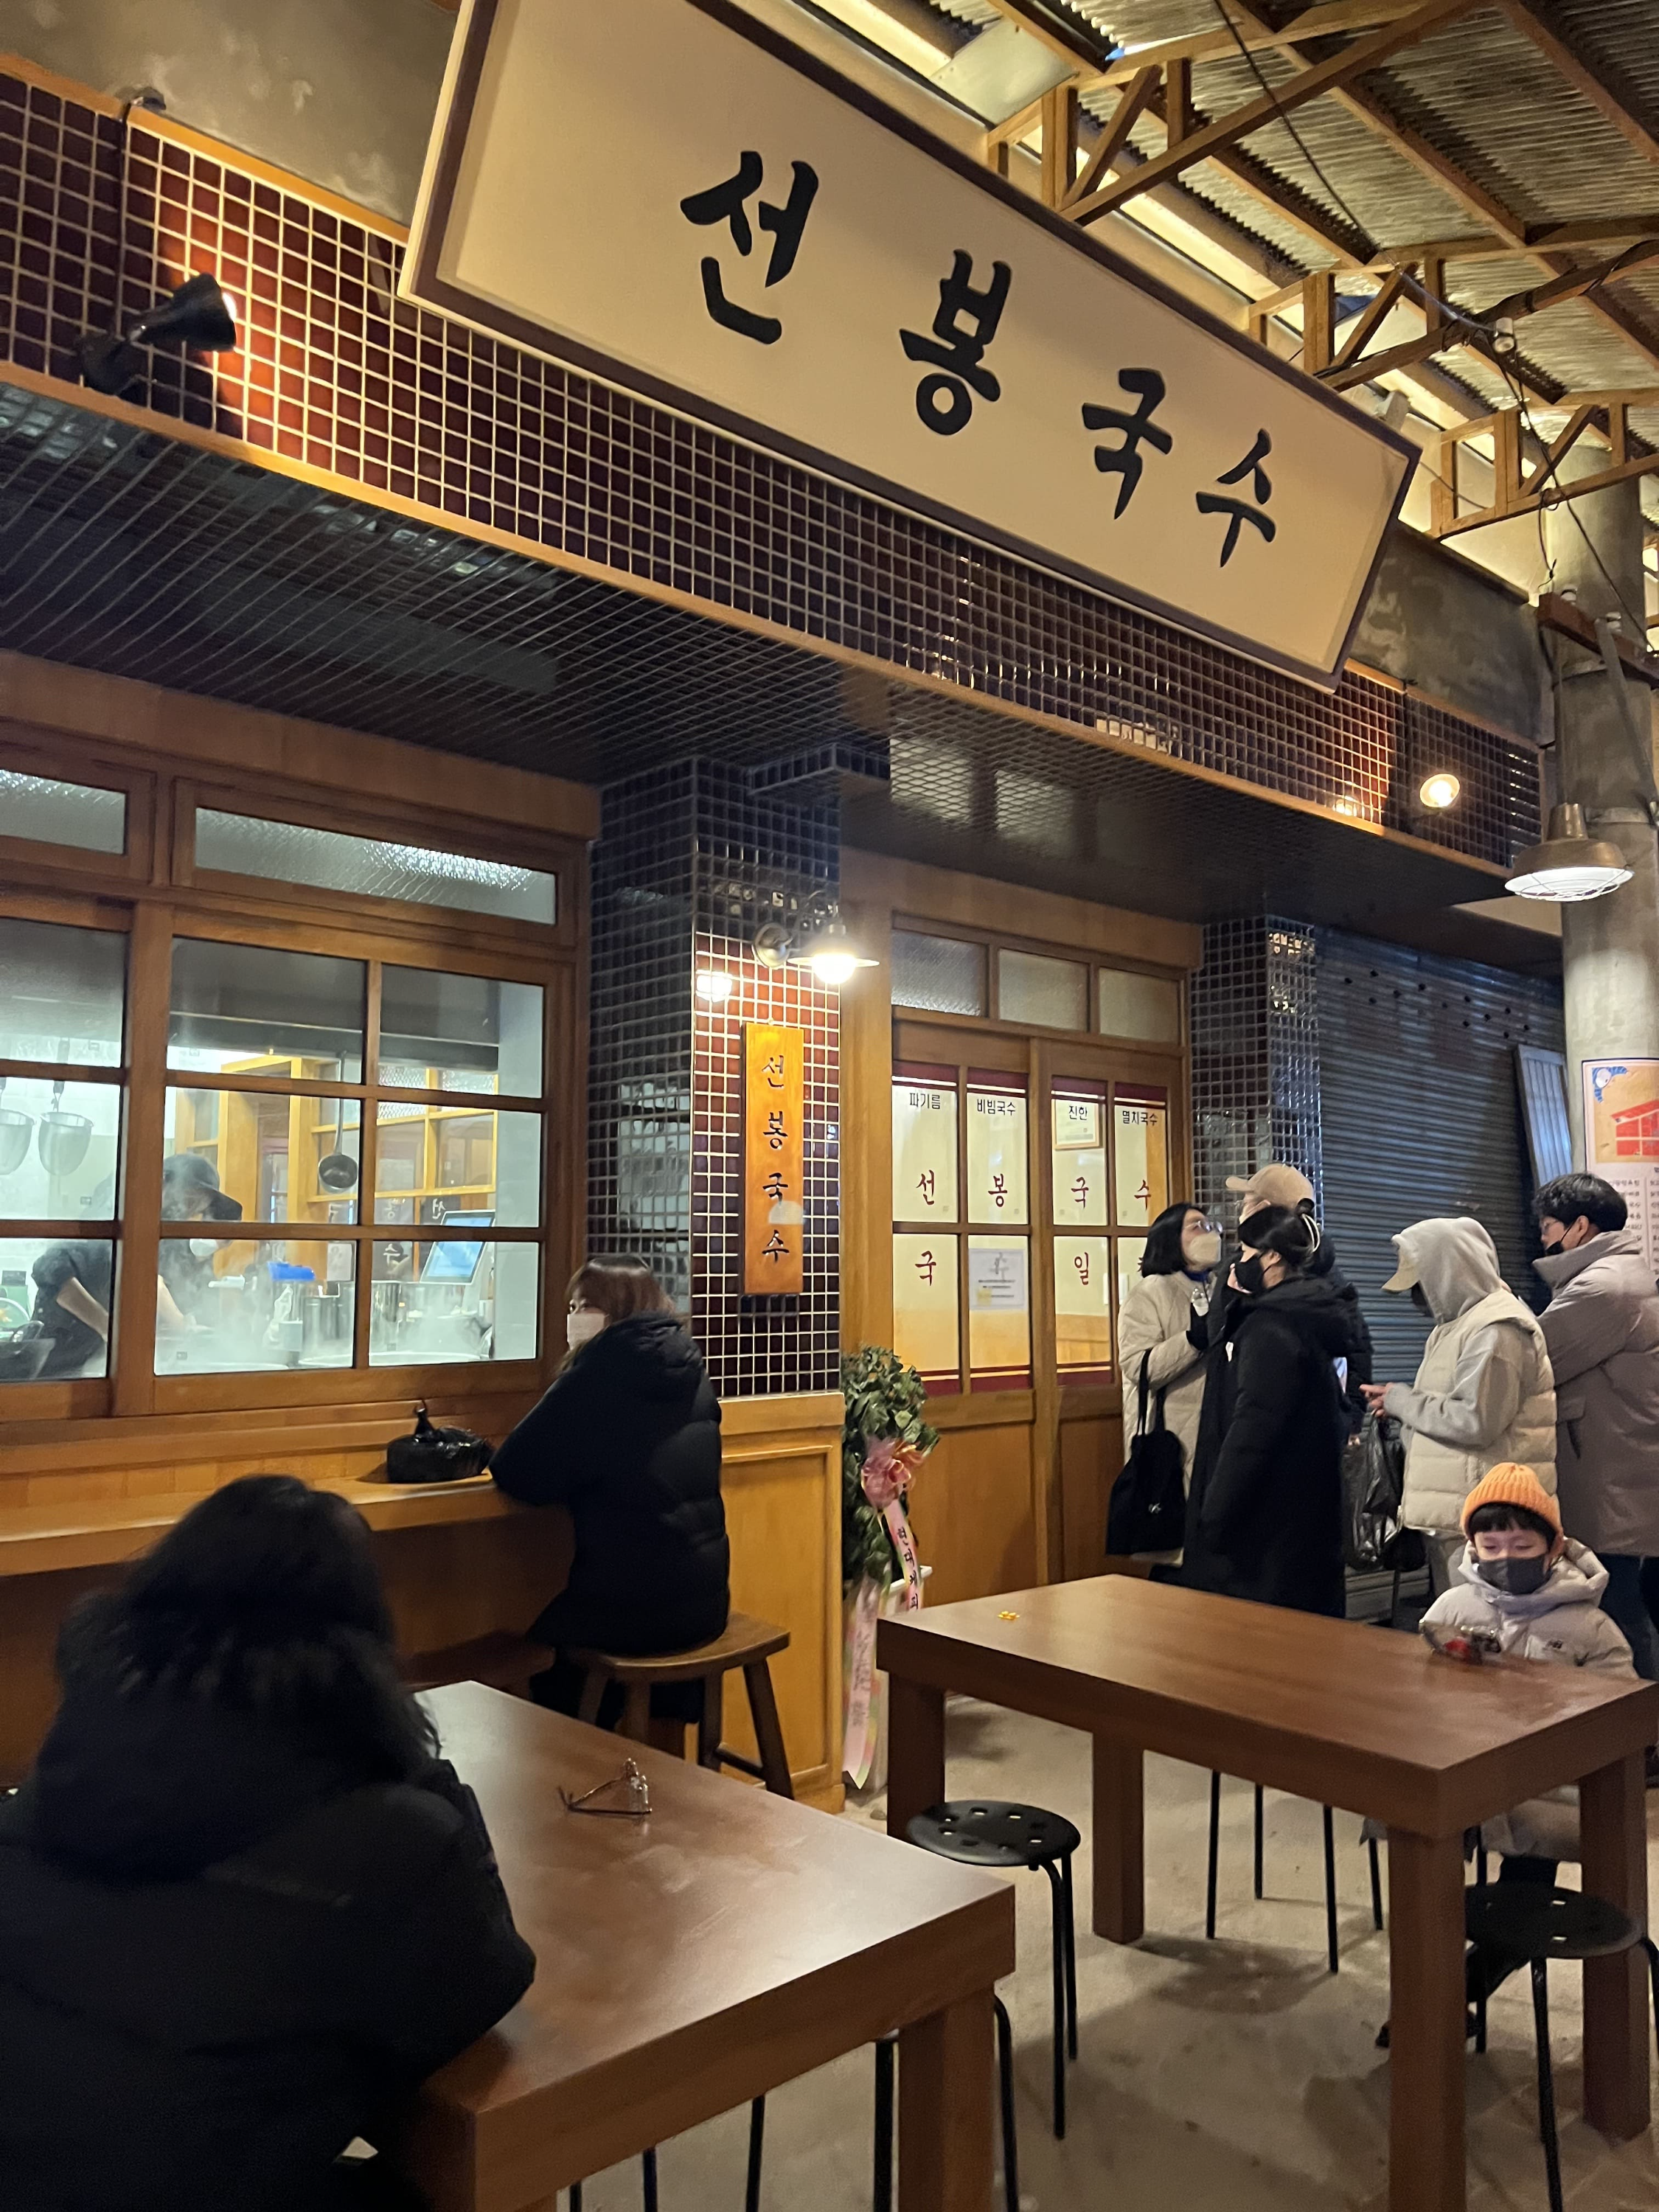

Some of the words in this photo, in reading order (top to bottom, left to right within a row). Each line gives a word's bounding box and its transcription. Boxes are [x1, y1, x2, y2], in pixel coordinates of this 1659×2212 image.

[681, 150, 1277, 568] 선봉국수
[761, 1054, 790, 1263] 선봉국수
[909, 1092, 941, 1110] 파기름
[976, 1098, 1016, 1116] 비빔국수
[1068, 1105, 1088, 1121] 진한
[1122, 1110, 1158, 1126] 멸치국수
